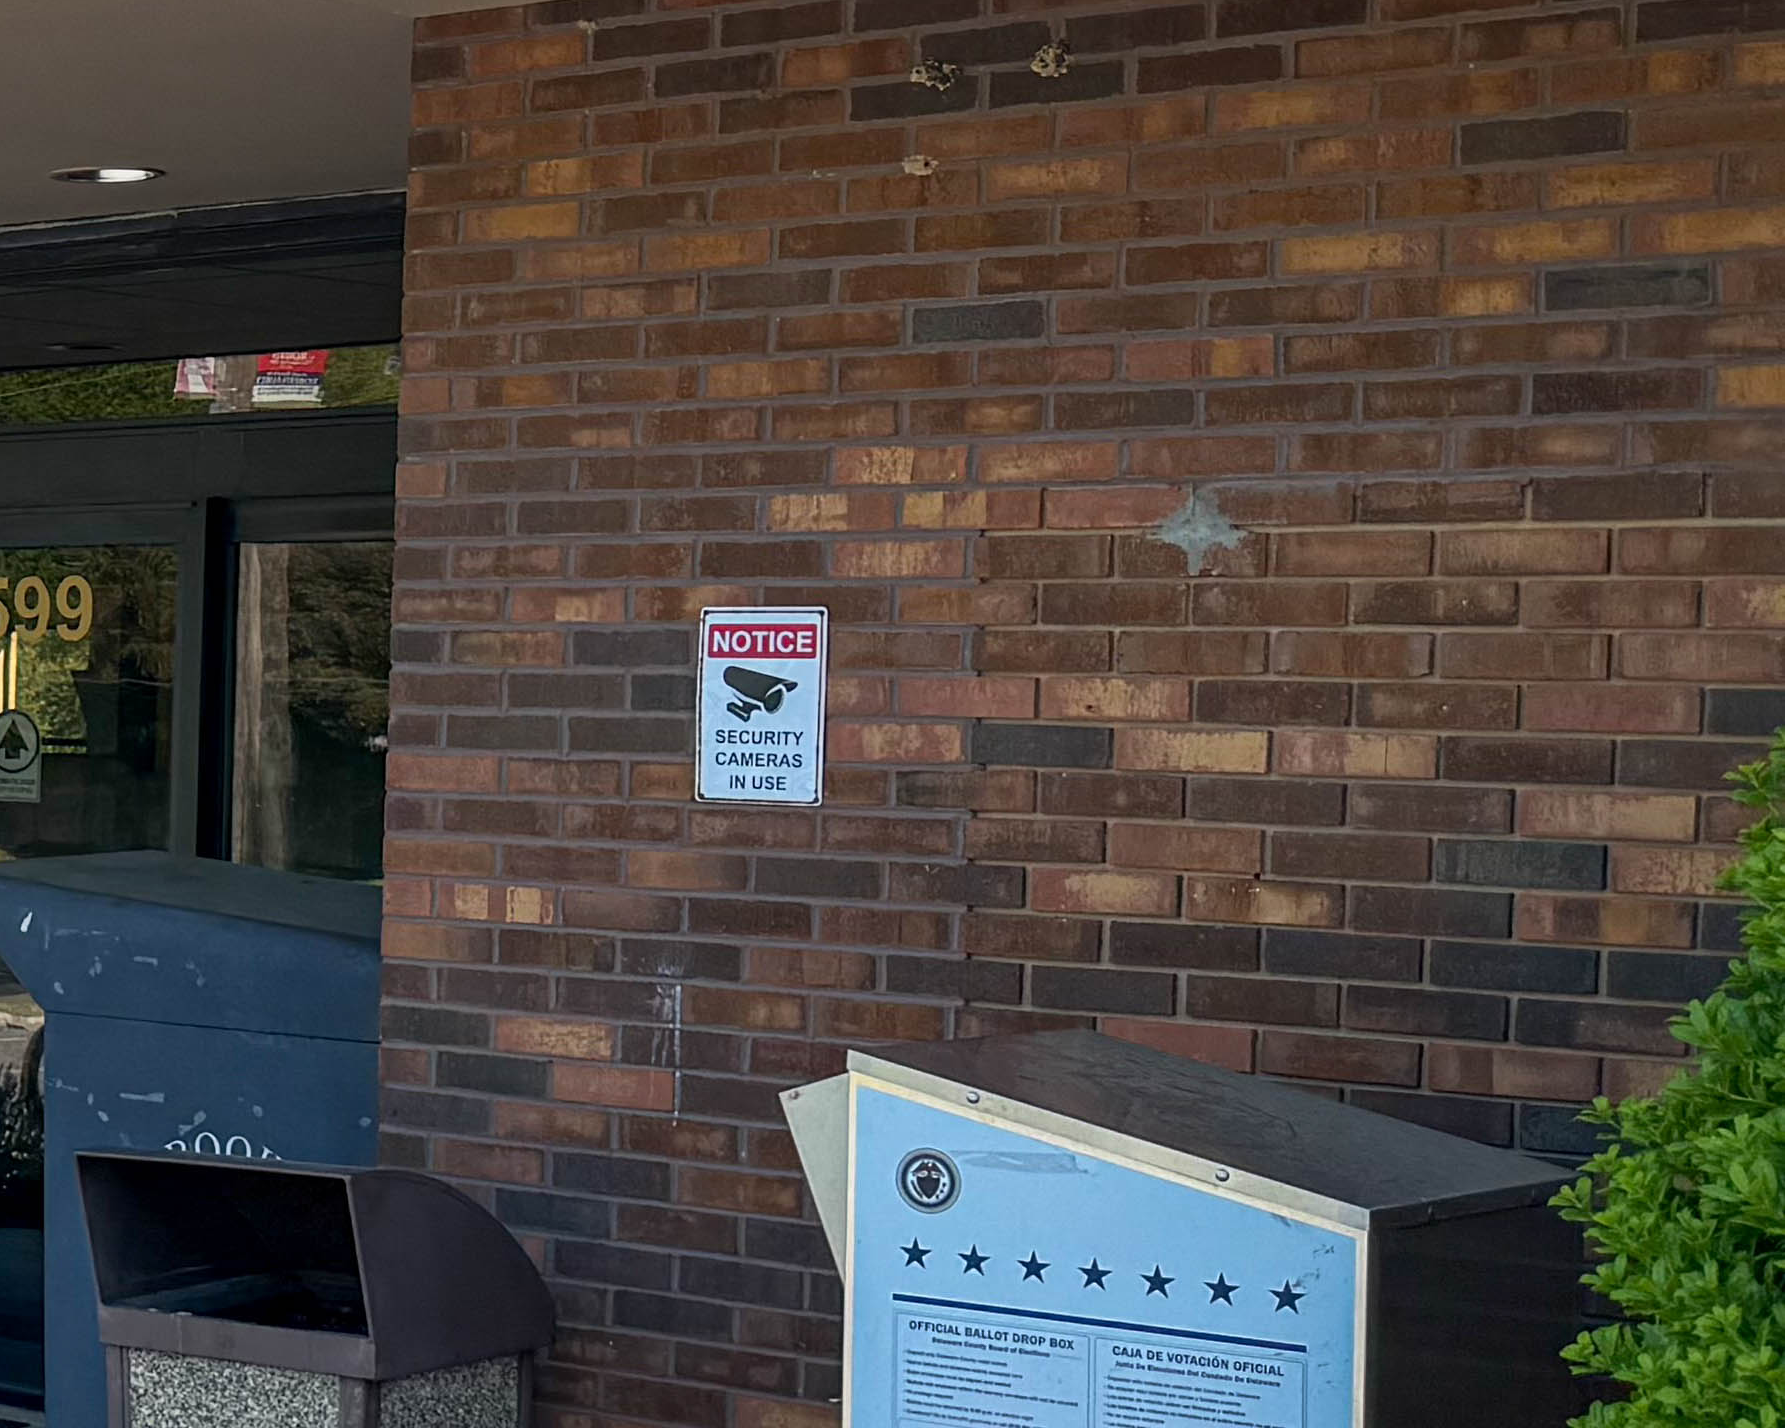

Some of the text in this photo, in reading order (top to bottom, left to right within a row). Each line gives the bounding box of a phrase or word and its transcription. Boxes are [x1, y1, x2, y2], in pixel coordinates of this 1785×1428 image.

[711, 630, 814, 653] NOTICE
[715, 729, 804, 746] SECURITY
[715, 752, 803, 768] CAMERAS
[729, 775, 786, 791] IN USE
[909, 1320, 1075, 1350] OFFICIAL BALLOT DROP BOX
[1112, 1345, 1285, 1377] CAJA DE VOTACIÓN OFICIAL
